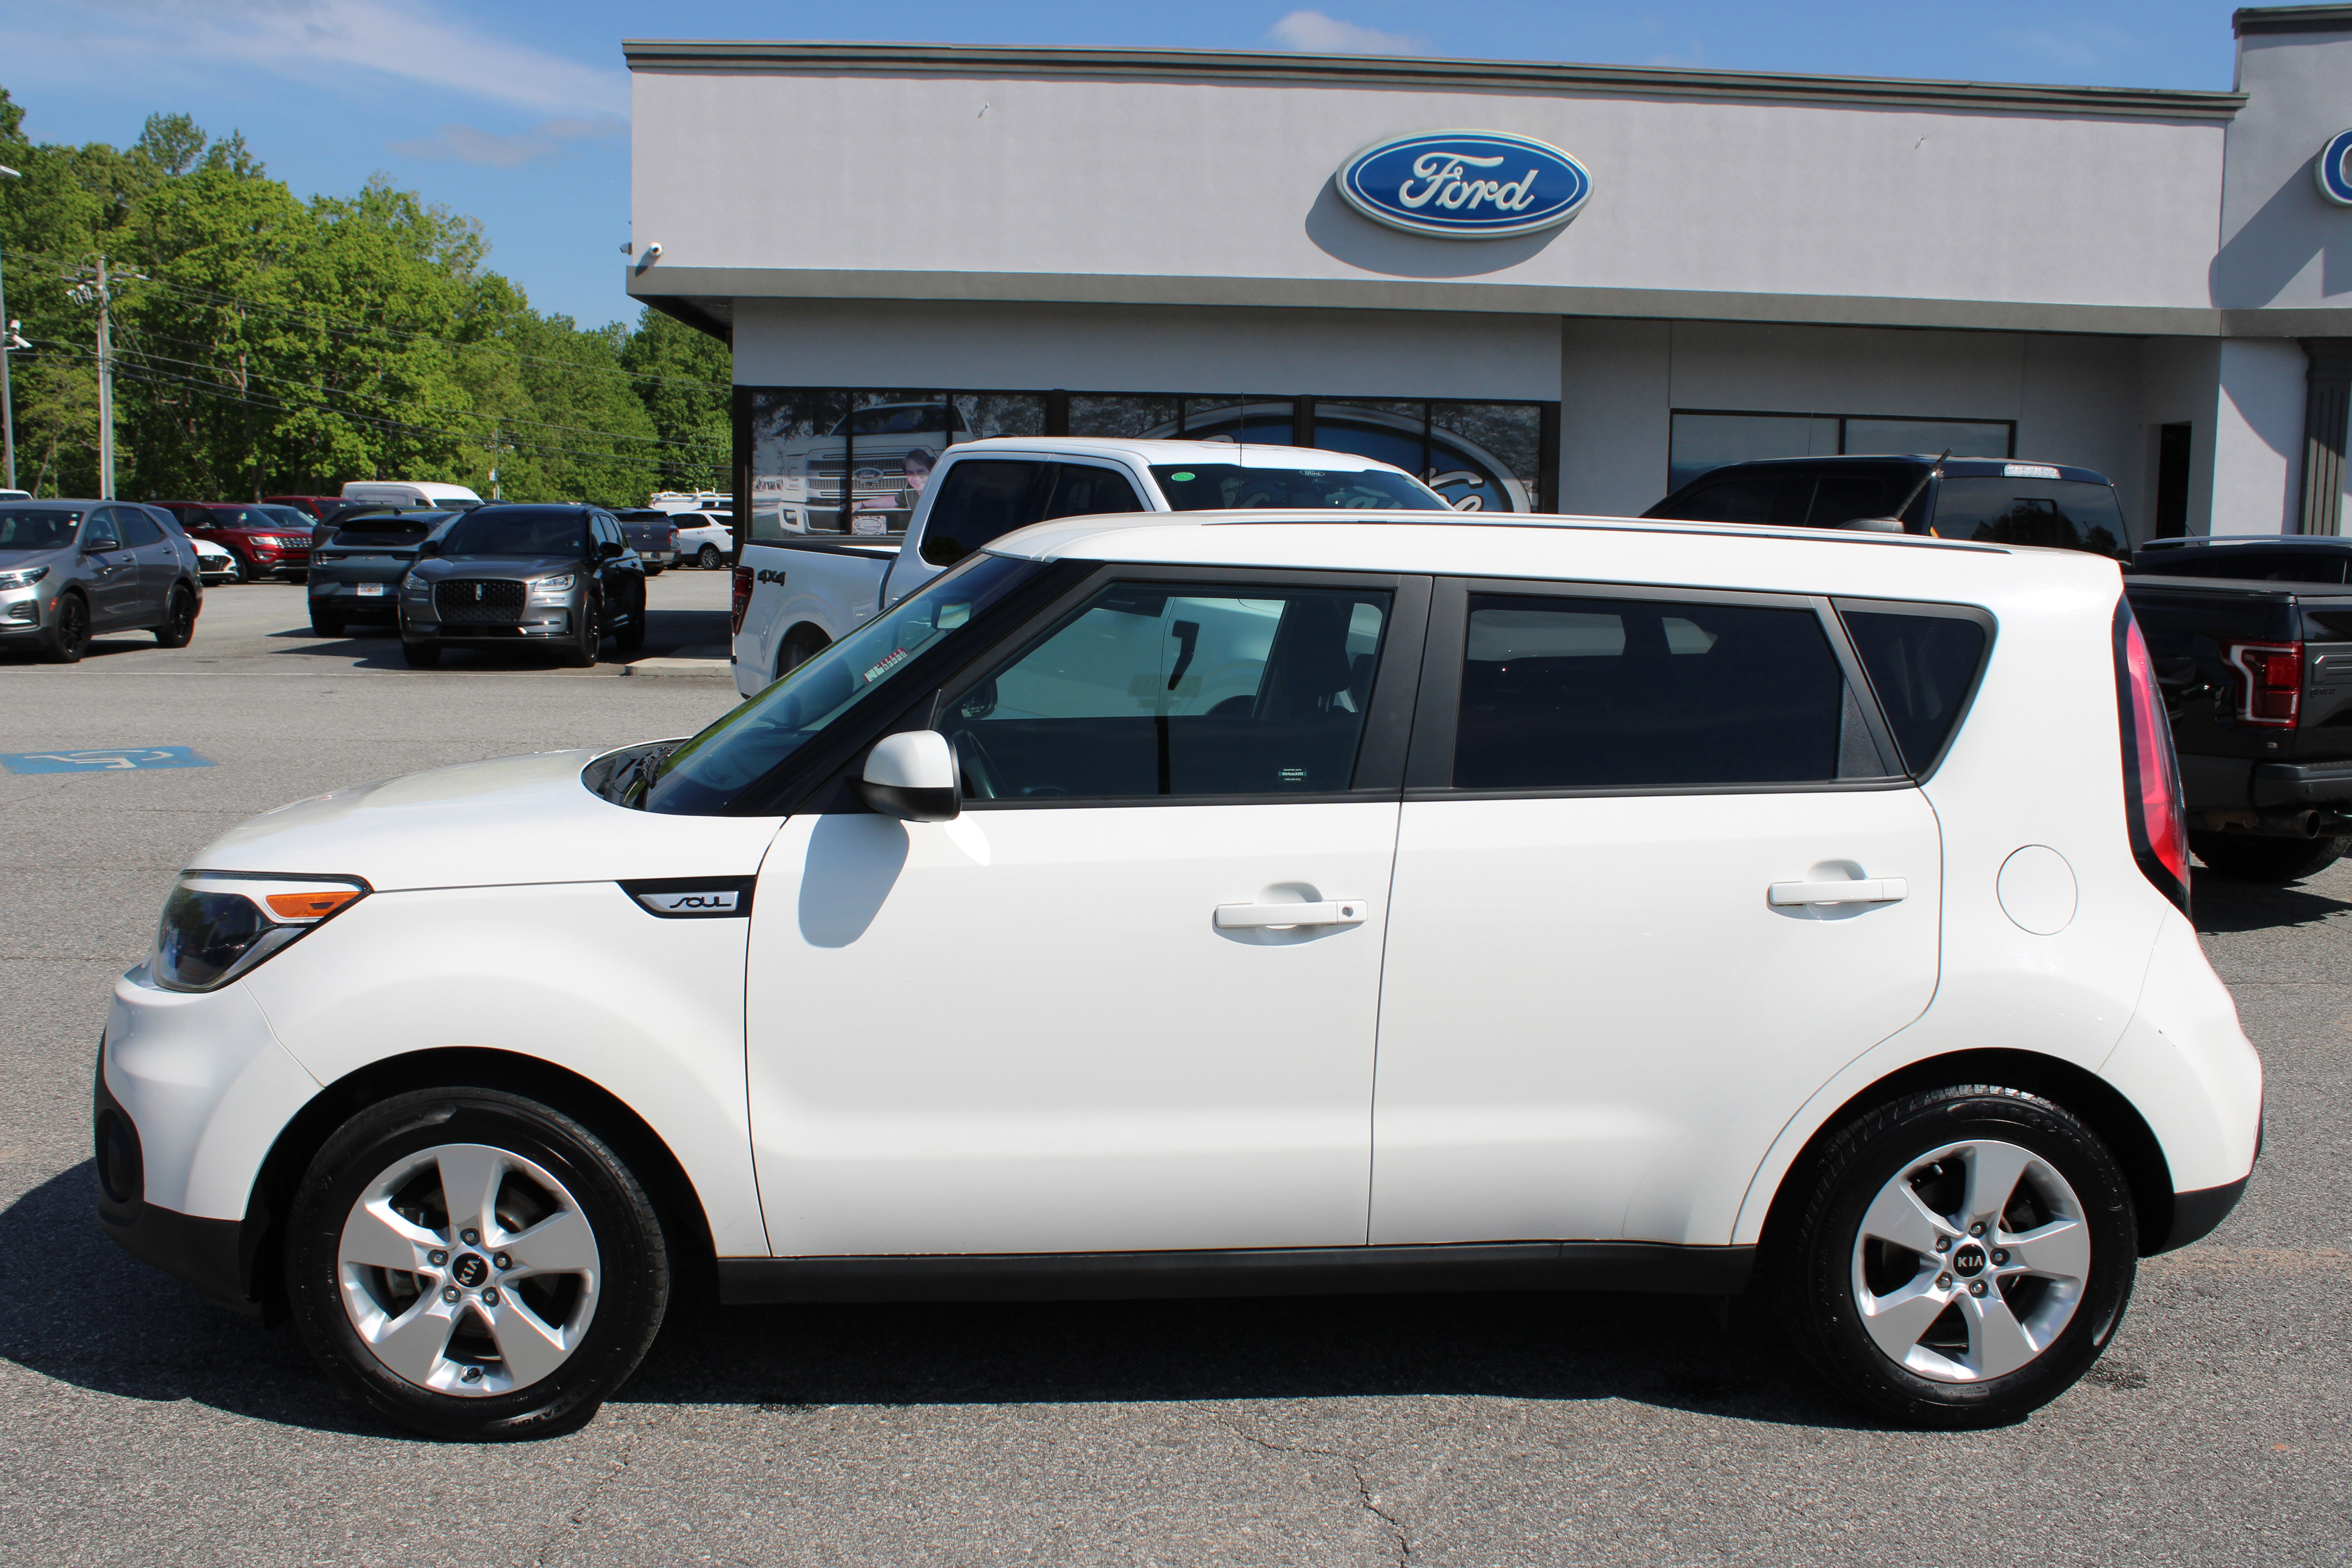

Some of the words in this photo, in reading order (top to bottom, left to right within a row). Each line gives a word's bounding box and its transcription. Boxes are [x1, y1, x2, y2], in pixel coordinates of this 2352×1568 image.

[1398, 151, 1539, 211] Ford
[669, 896, 732, 909] SOUL
[1957, 1255, 1983, 1267] KIA
[459, 1259, 480, 1285] KIA
